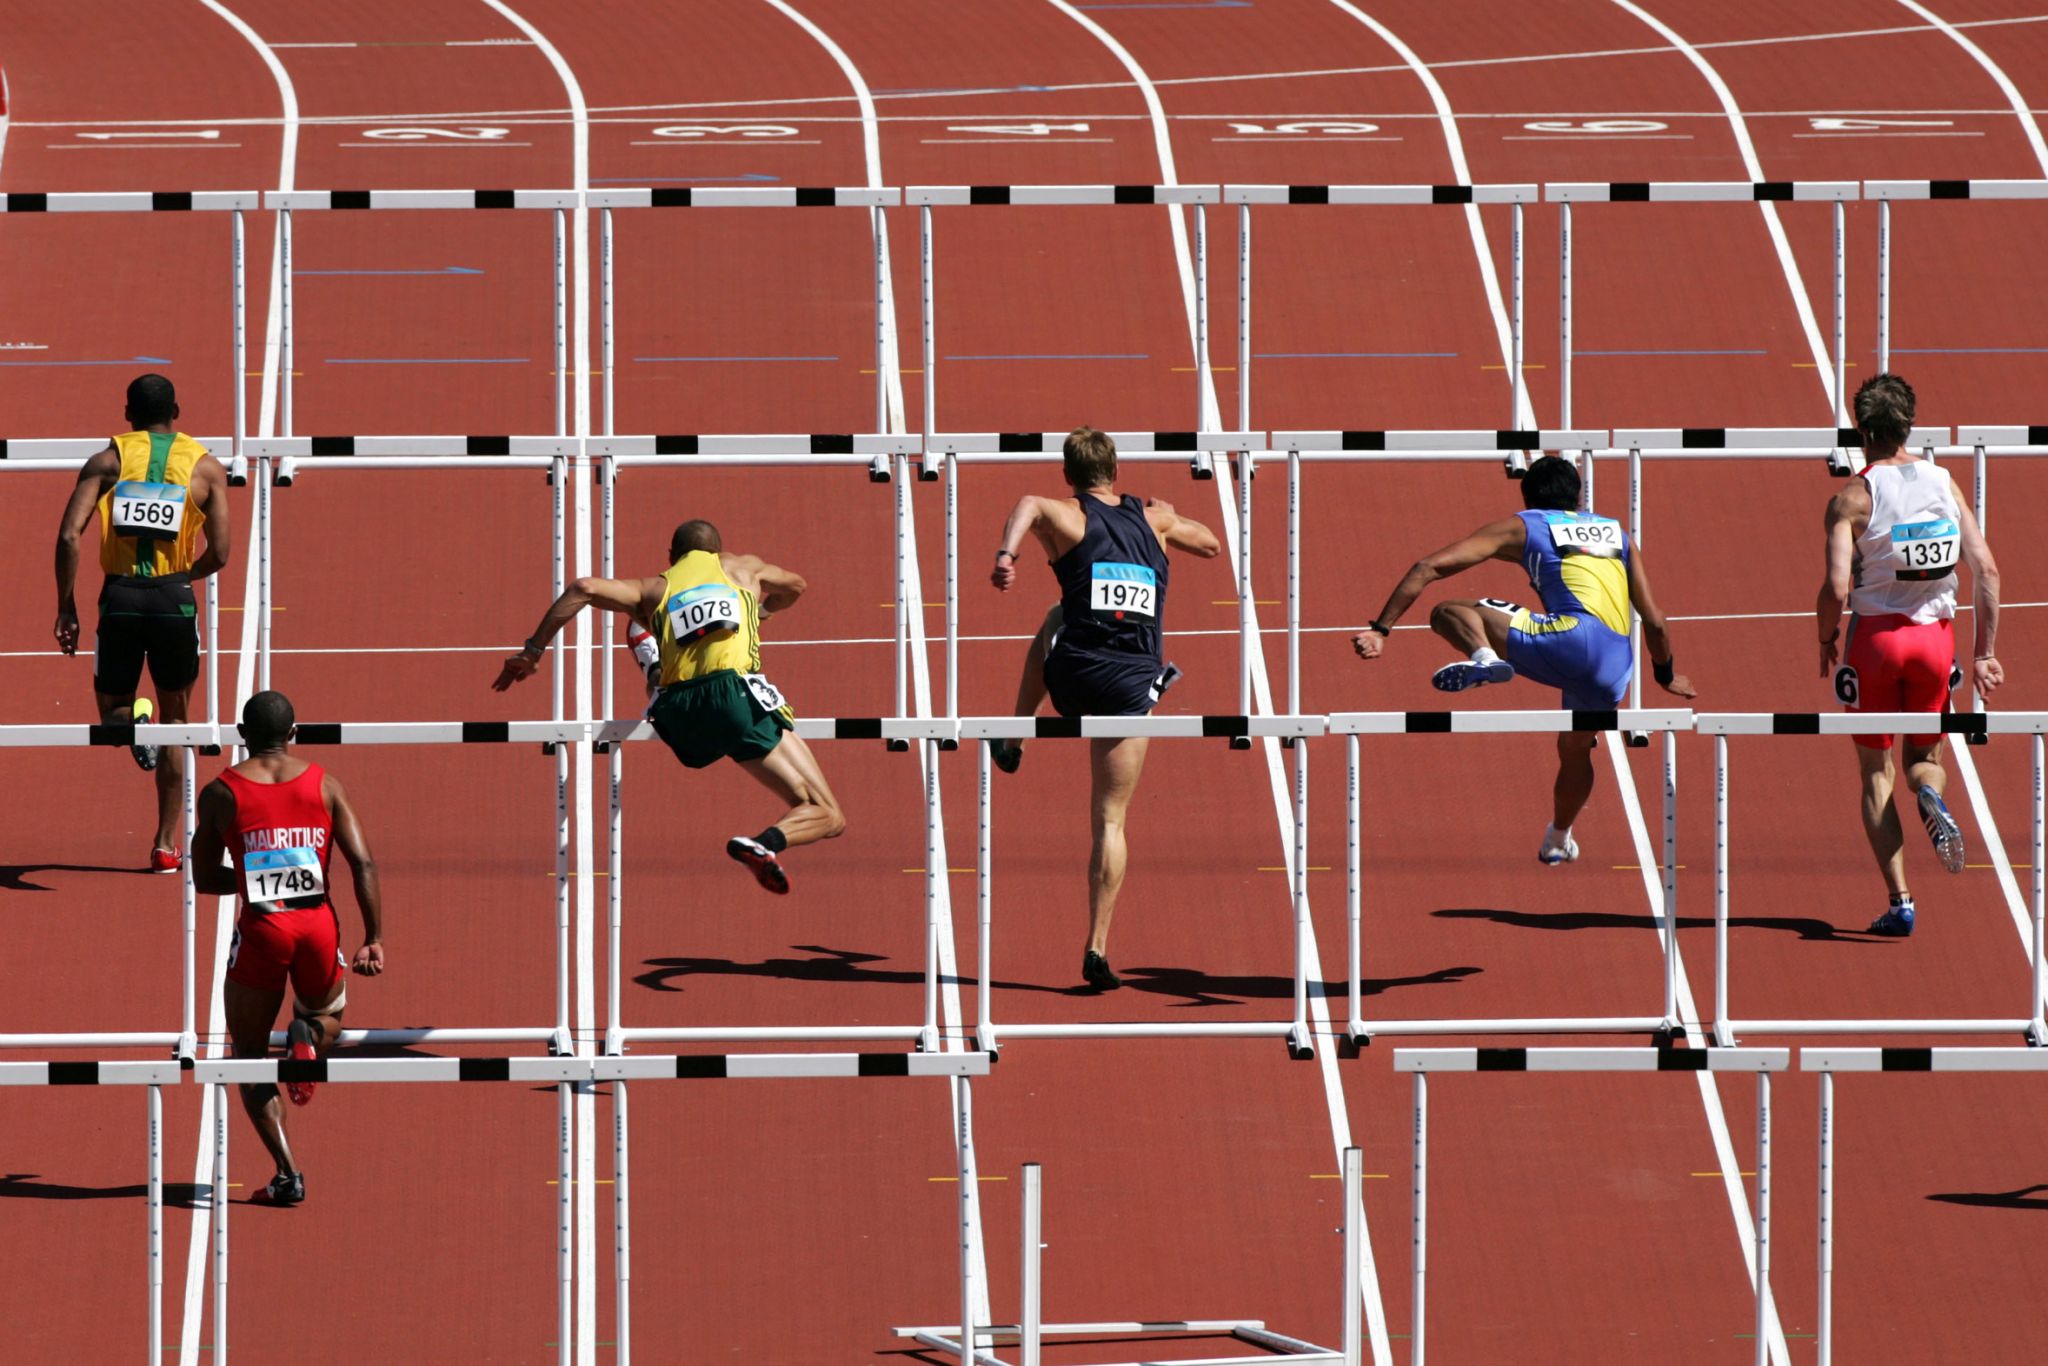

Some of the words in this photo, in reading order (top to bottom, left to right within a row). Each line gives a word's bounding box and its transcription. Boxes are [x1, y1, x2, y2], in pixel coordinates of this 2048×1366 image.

[362, 127, 509, 139] 2
[652, 125, 799, 137] 3
[947, 123, 1089, 135] 4
[1229, 122, 1379, 133] 5
[1524, 121, 1668, 133] 6
[1809, 118, 1953, 130] 7
[76, 130, 220, 139] 1
[122, 502, 175, 526] 1569
[1562, 525, 1616, 545] 1692
[1902, 541, 1954, 567] 1337
[1101, 584, 1150, 610] 1972
[679, 600, 733, 630] 1078
[1835, 667, 1858, 704] 6
[243, 827, 326, 853] MAURITIUS
[255, 869, 315, 897] 1748
